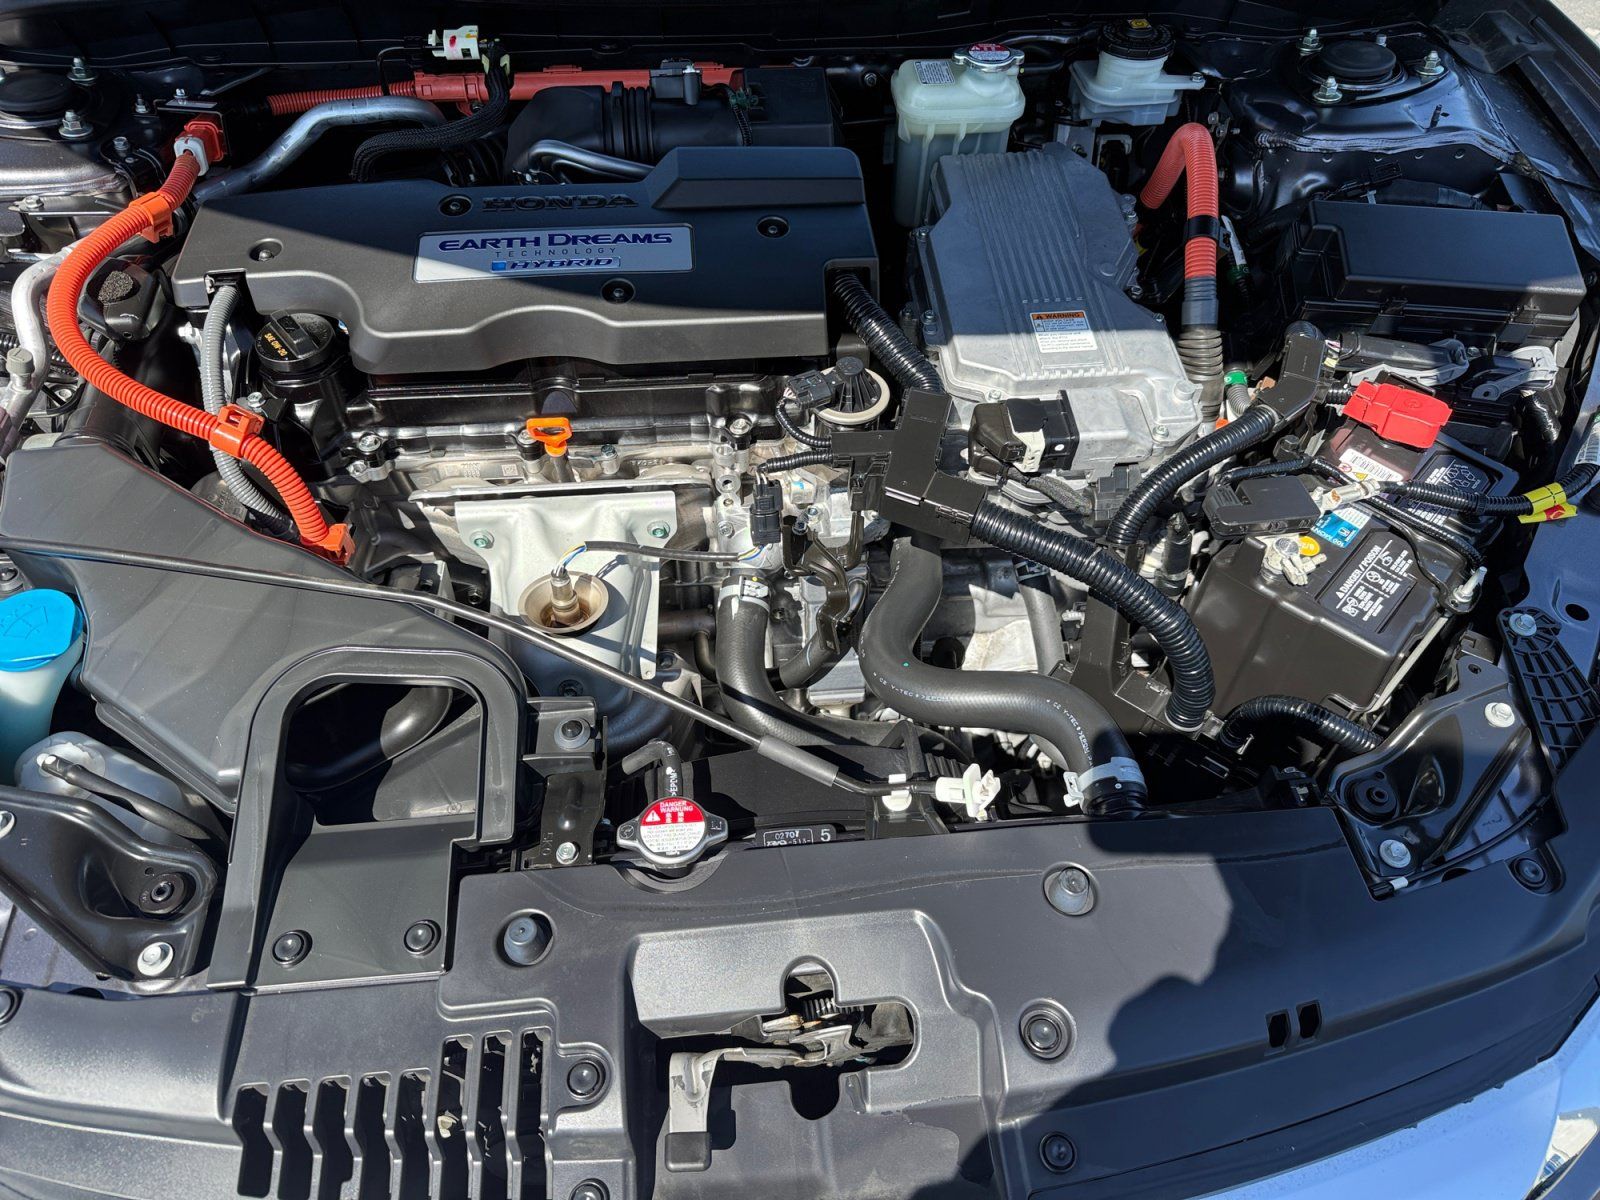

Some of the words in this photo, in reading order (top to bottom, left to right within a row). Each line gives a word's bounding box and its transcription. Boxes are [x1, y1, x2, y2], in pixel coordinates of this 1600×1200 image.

[482, 194, 639, 213] HONDA
[438, 237, 541, 252] EARTH
[548, 232, 673, 248] DREAMS
[495, 247, 617, 259] TECHNOLOGY
[510, 258, 614, 271] HYBRID
[1339, 567, 1363, 594] DANGER
[1361, 544, 1381, 567] POISON
[659, 800, 687, 808] DANGER
[659, 806, 694, 814] WARNUNG
[820, 828, 831, 842] 5
